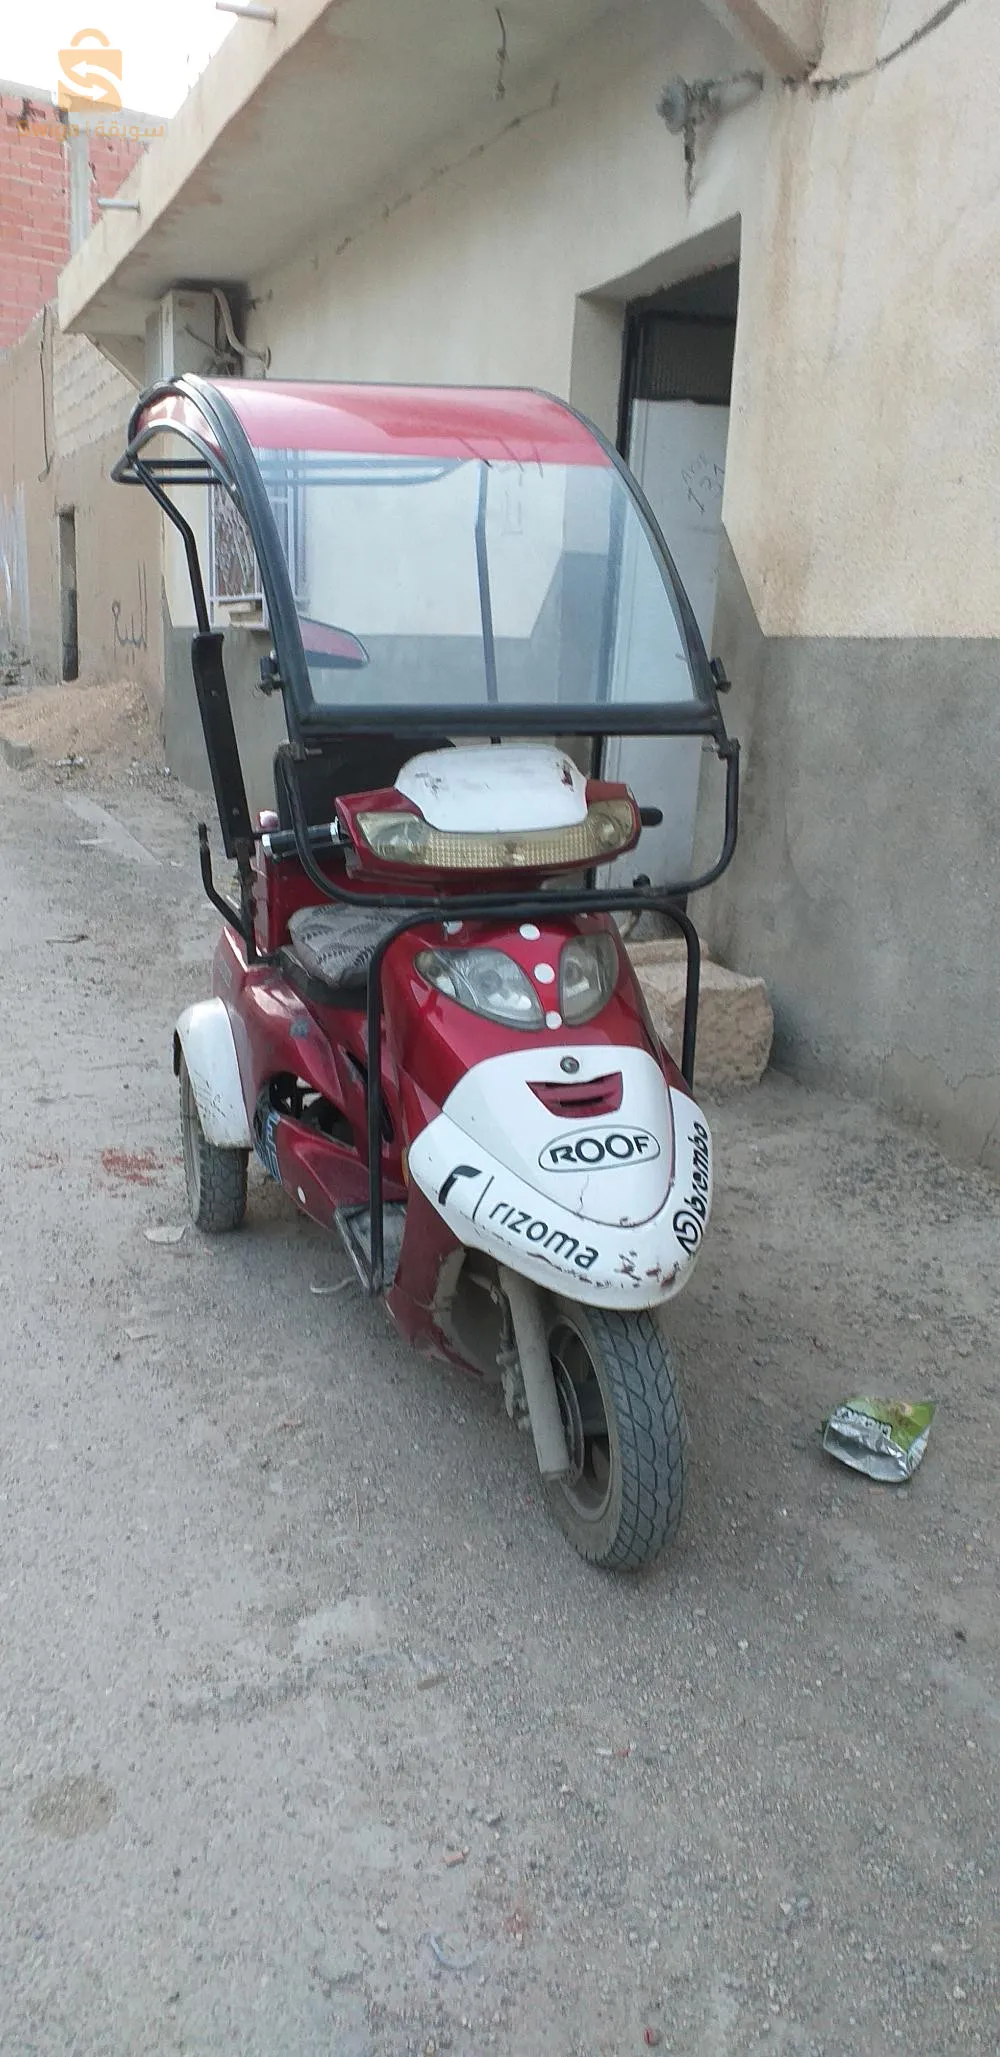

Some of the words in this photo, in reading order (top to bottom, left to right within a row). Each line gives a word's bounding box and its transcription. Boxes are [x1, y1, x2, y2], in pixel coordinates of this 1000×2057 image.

[549, 1133, 650, 1164] ROOF
[684, 1121, 709, 1222] brembo
[488, 1202, 600, 1271] rizoma
